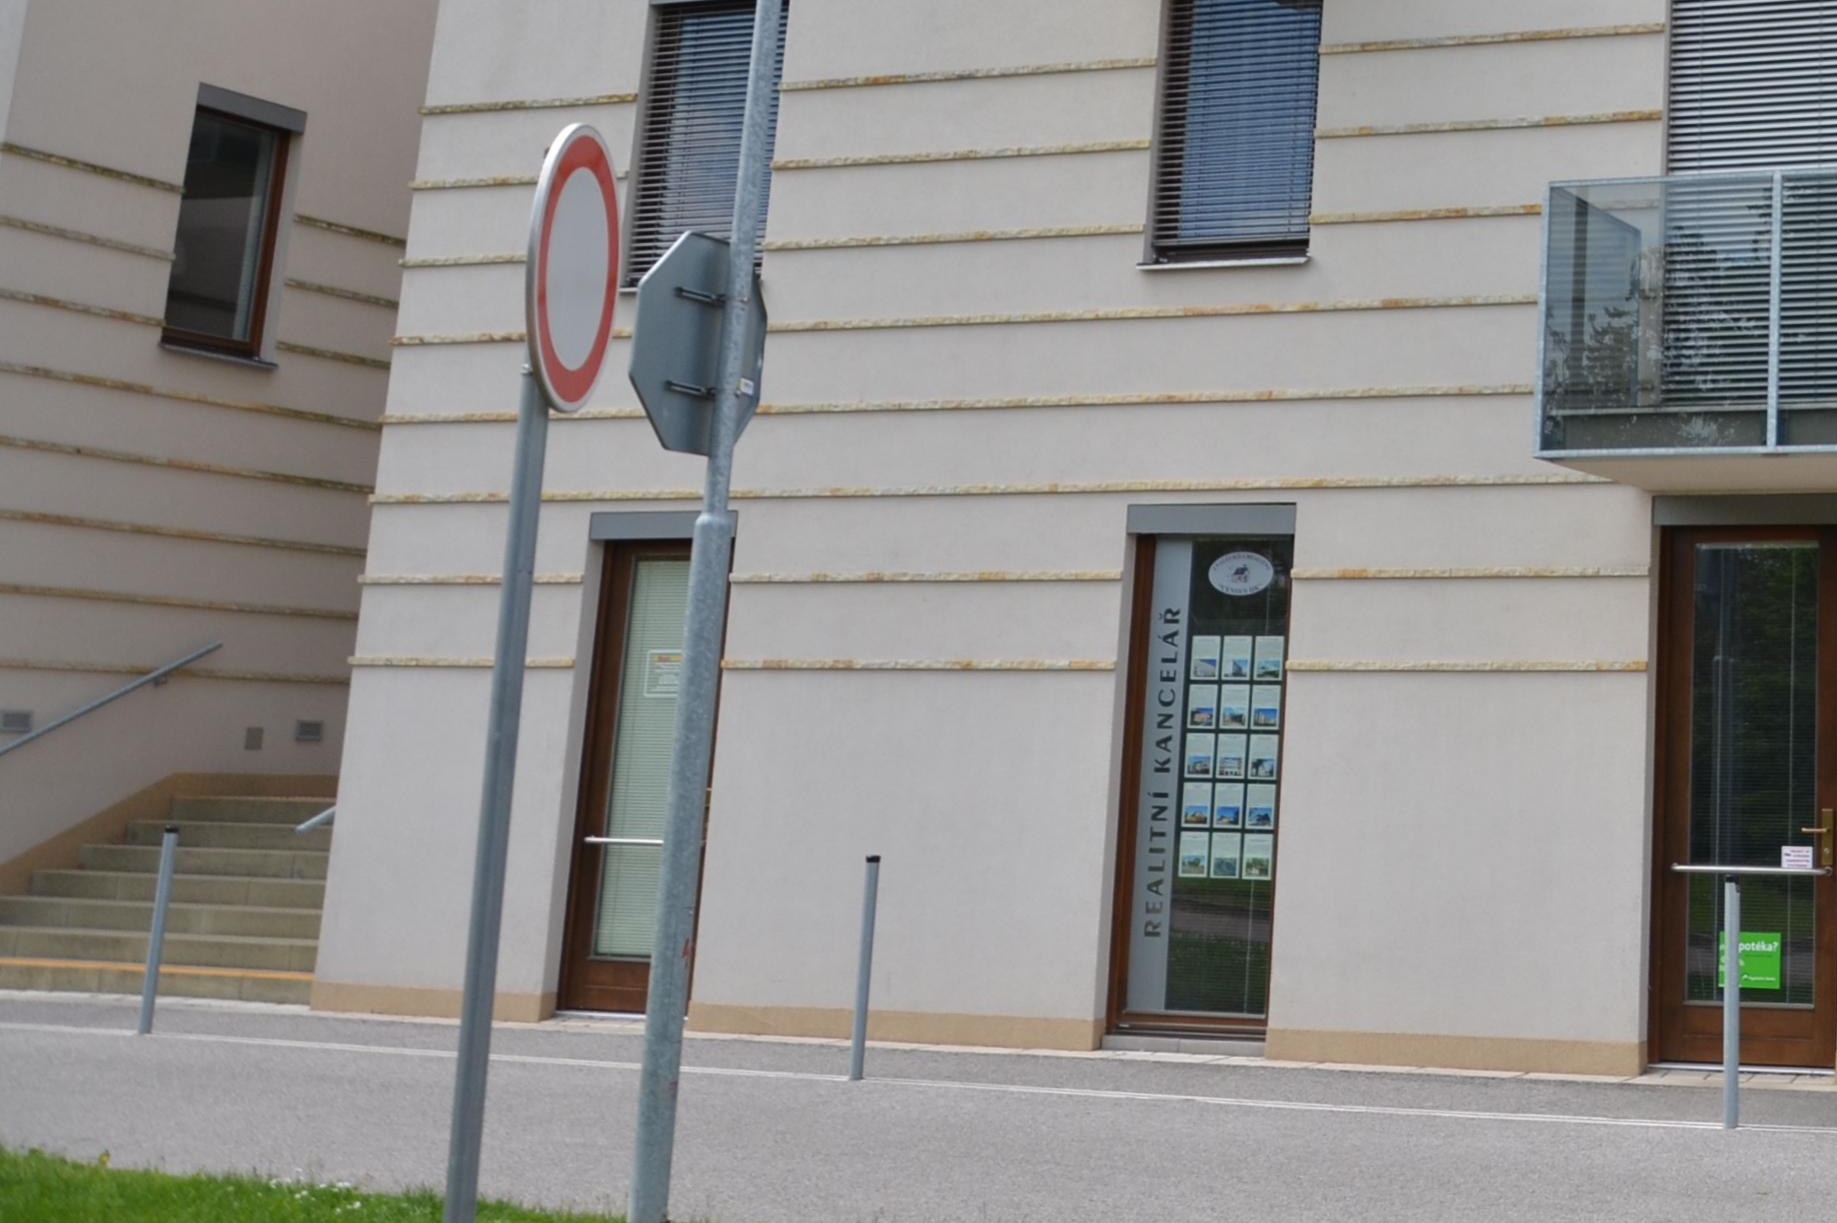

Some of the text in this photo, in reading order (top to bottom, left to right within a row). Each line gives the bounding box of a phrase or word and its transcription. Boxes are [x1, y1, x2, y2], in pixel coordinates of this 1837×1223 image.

[1144, 608, 1180, 937] REALITNÍ KANCELÁŘ
[1738, 941, 1778, 953] potéka?
